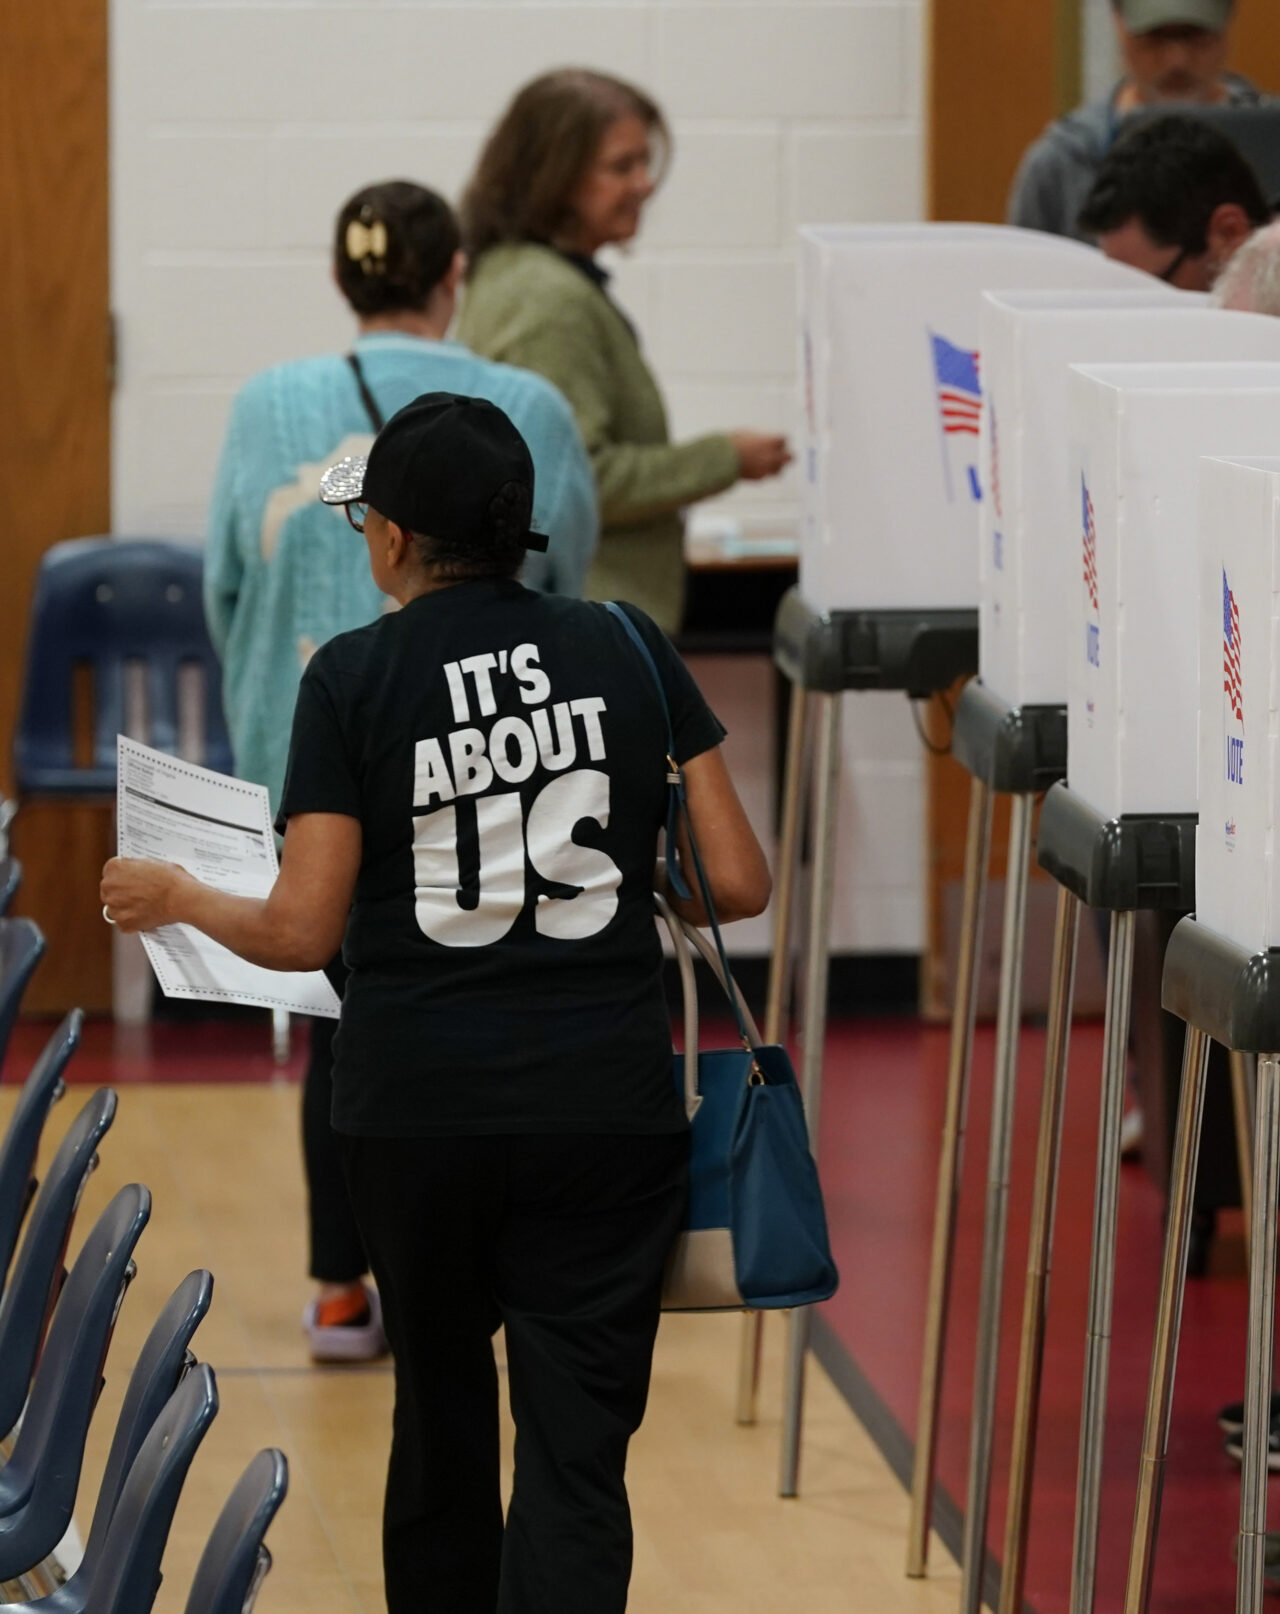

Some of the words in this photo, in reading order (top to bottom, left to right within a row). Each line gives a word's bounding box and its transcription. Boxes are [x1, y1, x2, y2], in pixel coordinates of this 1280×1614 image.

[443, 643, 551, 723] IT'S
[413, 697, 607, 807] ABOUT
[1226, 735, 1243, 785] VOTE
[411, 768, 624, 948] US
